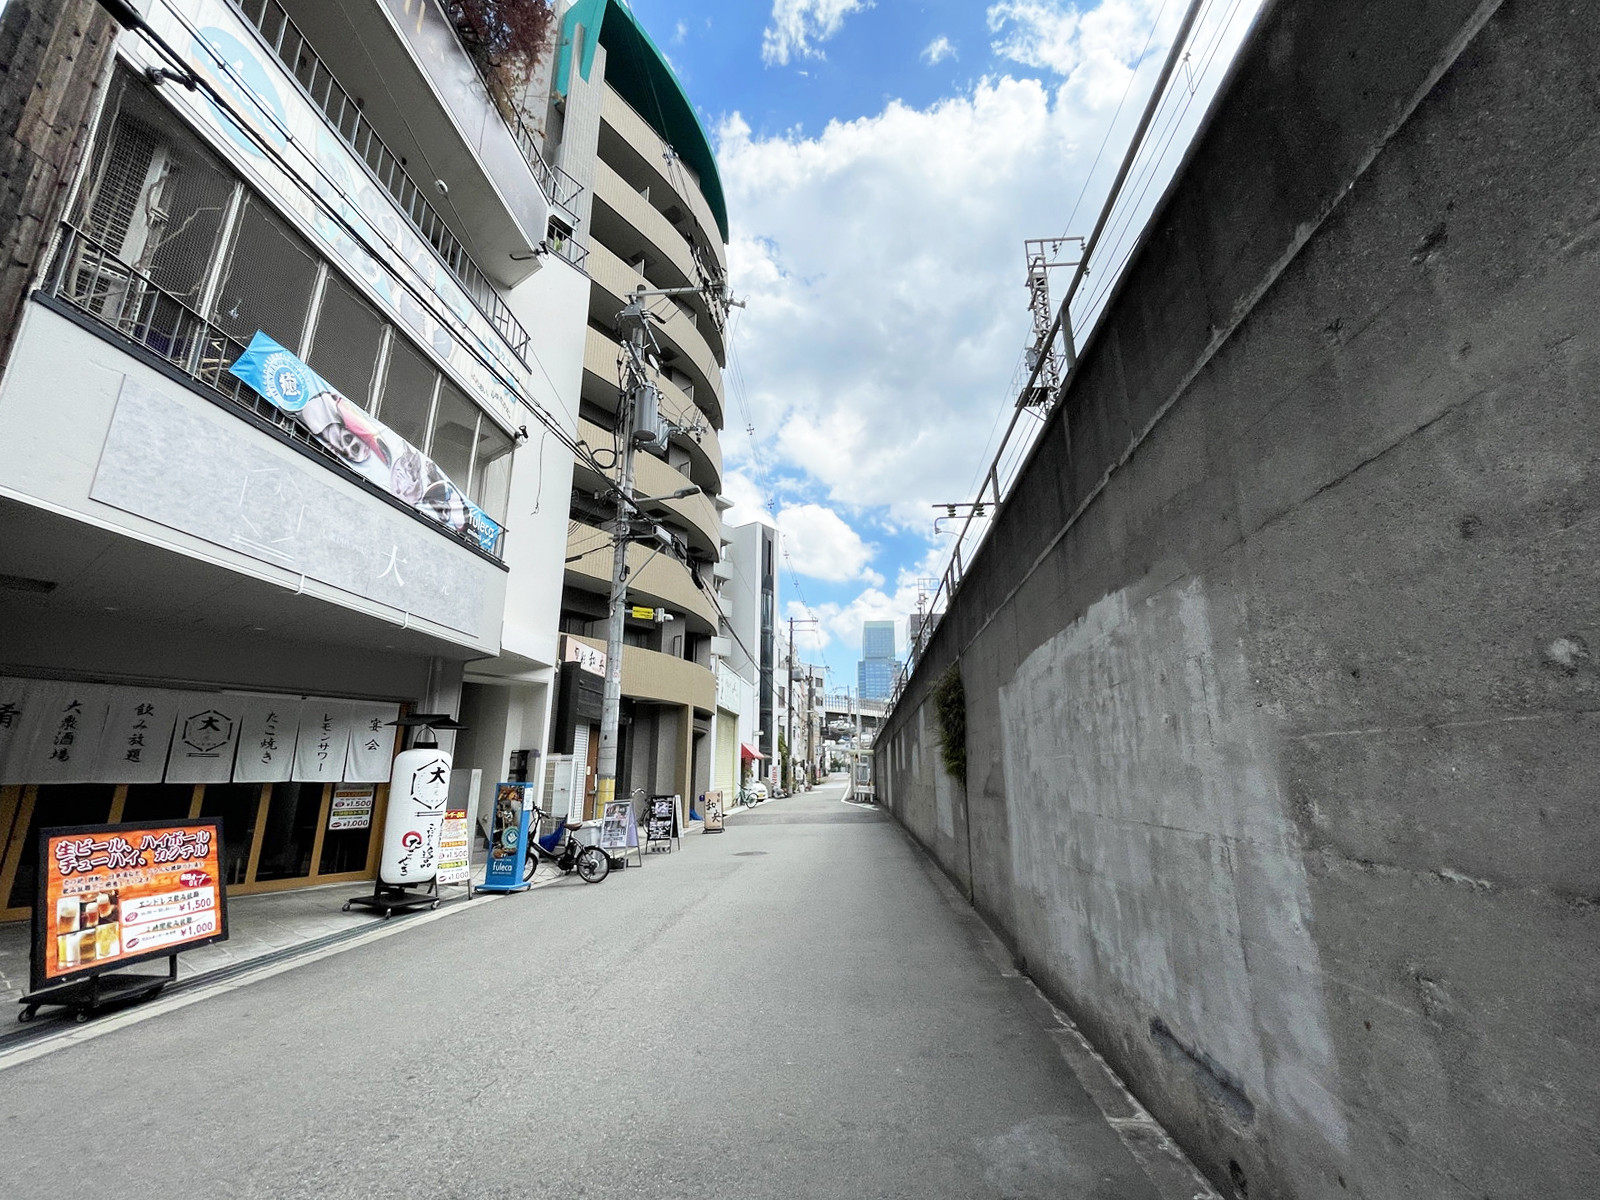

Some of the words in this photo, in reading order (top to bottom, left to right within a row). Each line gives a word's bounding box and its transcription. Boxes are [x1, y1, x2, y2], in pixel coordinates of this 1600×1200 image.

[49, 699, 83, 763] 大衆酒場
[124, 703, 155, 763] 飲み放題
[199, 716, 221, 732] 大
[260, 711, 279, 764] たこ焼き
[364, 718, 383, 751] 宴会
[317, 713, 334, 772] レモンサワー
[426, 766, 446, 784] 大
[179, 897, 212, 912] ¥1,500
[180, 921, 213, 937] ¥1,000
